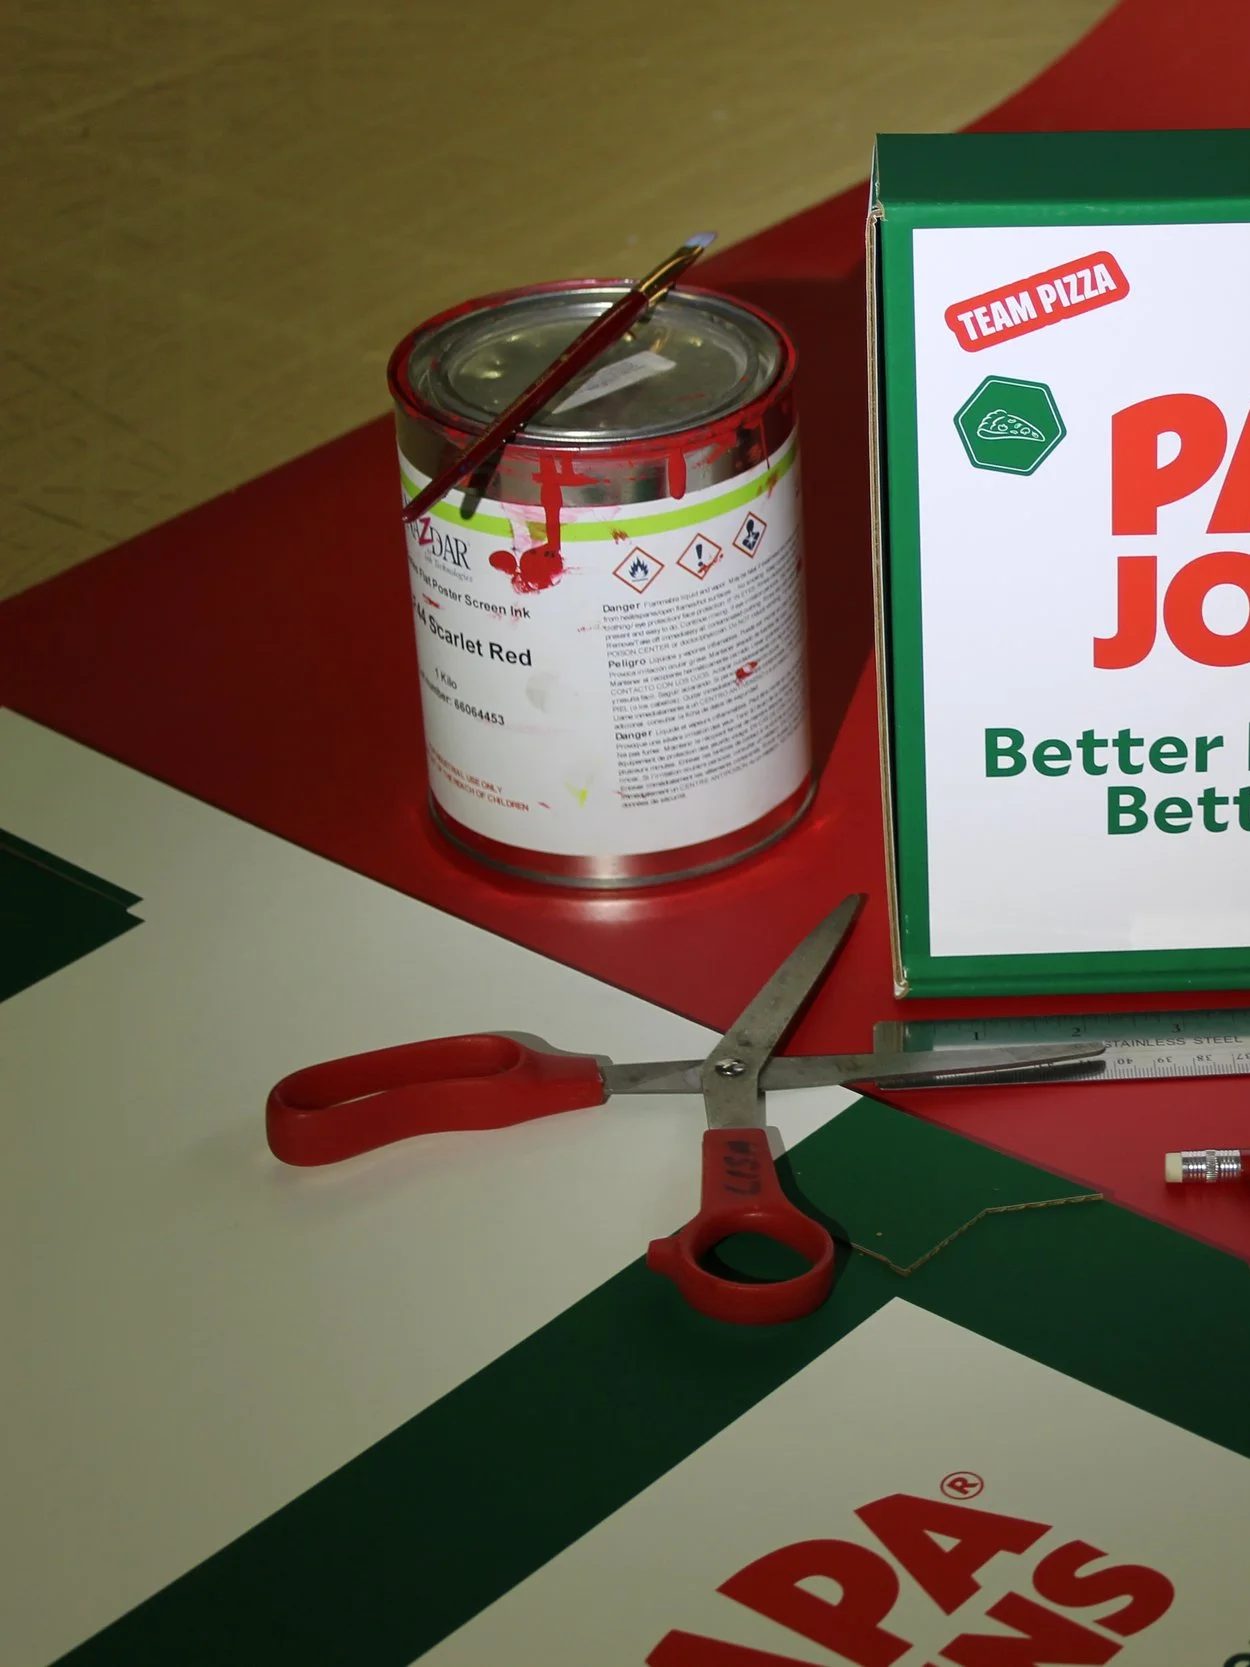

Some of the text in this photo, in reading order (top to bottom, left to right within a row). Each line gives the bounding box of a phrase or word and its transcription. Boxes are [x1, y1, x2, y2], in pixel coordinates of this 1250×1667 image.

[957, 263, 1117, 341] TEAM PIZZA
[432, 578, 461, 602] Poster
[464, 594, 507, 616] Screen
[510, 604, 532, 619] Ink
[603, 603, 640, 613] Danger
[428, 614, 483, 657] Scarlet
[489, 641, 532, 667] Red
[608, 658, 646, 669] Peligro
[440, 671, 457, 690] Kilo
[454, 698, 505, 726] 66064453
[615, 731, 652, 740] Danger
[984, 726, 1224, 778] Better
[487, 794, 530, 812] CHILDREN
[1104, 1035, 1243, 1049] STAINLESS STEEL
